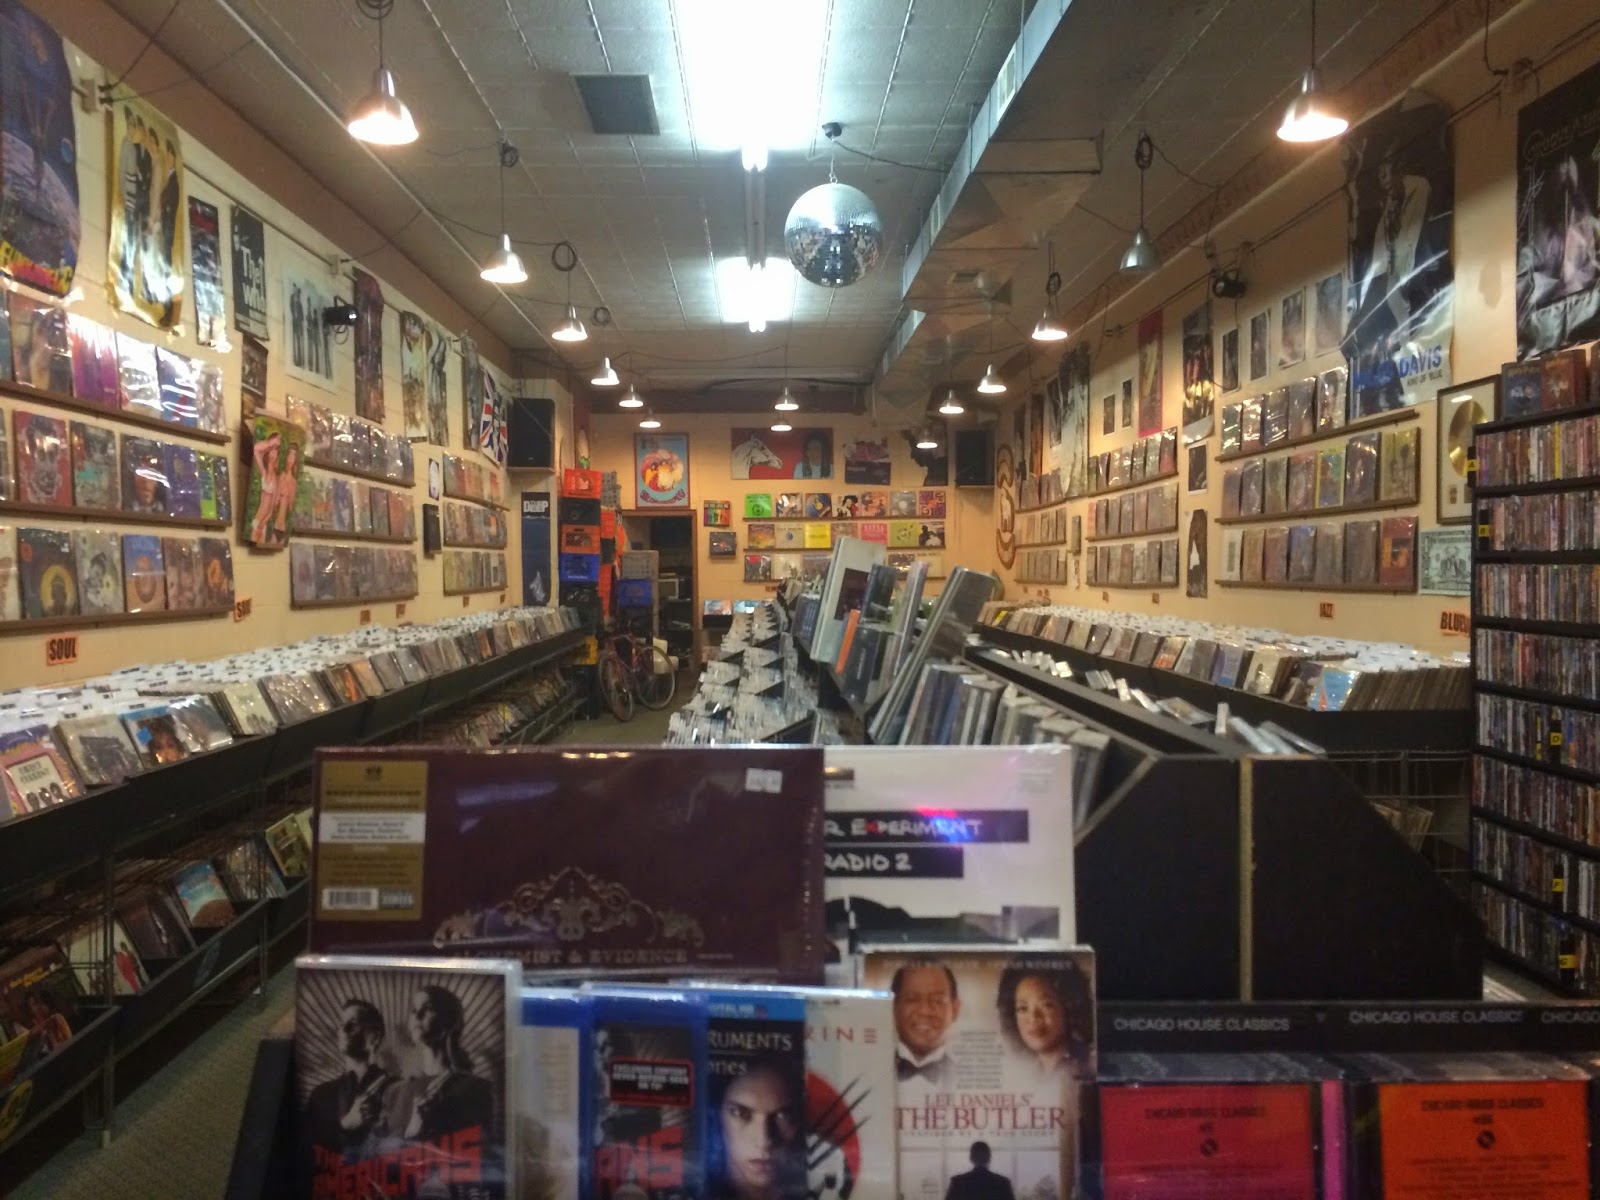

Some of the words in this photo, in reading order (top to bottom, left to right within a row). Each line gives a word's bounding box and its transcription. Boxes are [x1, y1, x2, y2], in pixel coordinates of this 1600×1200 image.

[1400, 344, 1442, 379] DAVIS
[523, 500, 549, 513] DEEP
[1319, 602, 1334, 618] JAZZ
[49, 637, 77, 661] SOUL
[851, 817, 984, 838] EXPERIMENT
[824, 853, 890, 871] RADIO
[895, 853, 912, 871] 2
[590, 948, 688, 964] EVIDENCE
[1114, 1017, 1175, 1032] CHICAGO
[1177, 1017, 1223, 1032] HOUSE
[1225, 1017, 1290, 1032] CLASSICS
[1350, 1011, 1412, 1024] CHICAGO
[1413, 1010, 1460, 1024] HOUSE
[1541, 1011, 1600, 1024] CHICAGO
[707, 1031, 793, 1051] RUMENTS
[925, 1093, 953, 1108] LEE
[896, 1106, 948, 1131] THE
[953, 1106, 1067, 1131] BUTLER
[312, 1124, 482, 1200] AMERICANS
